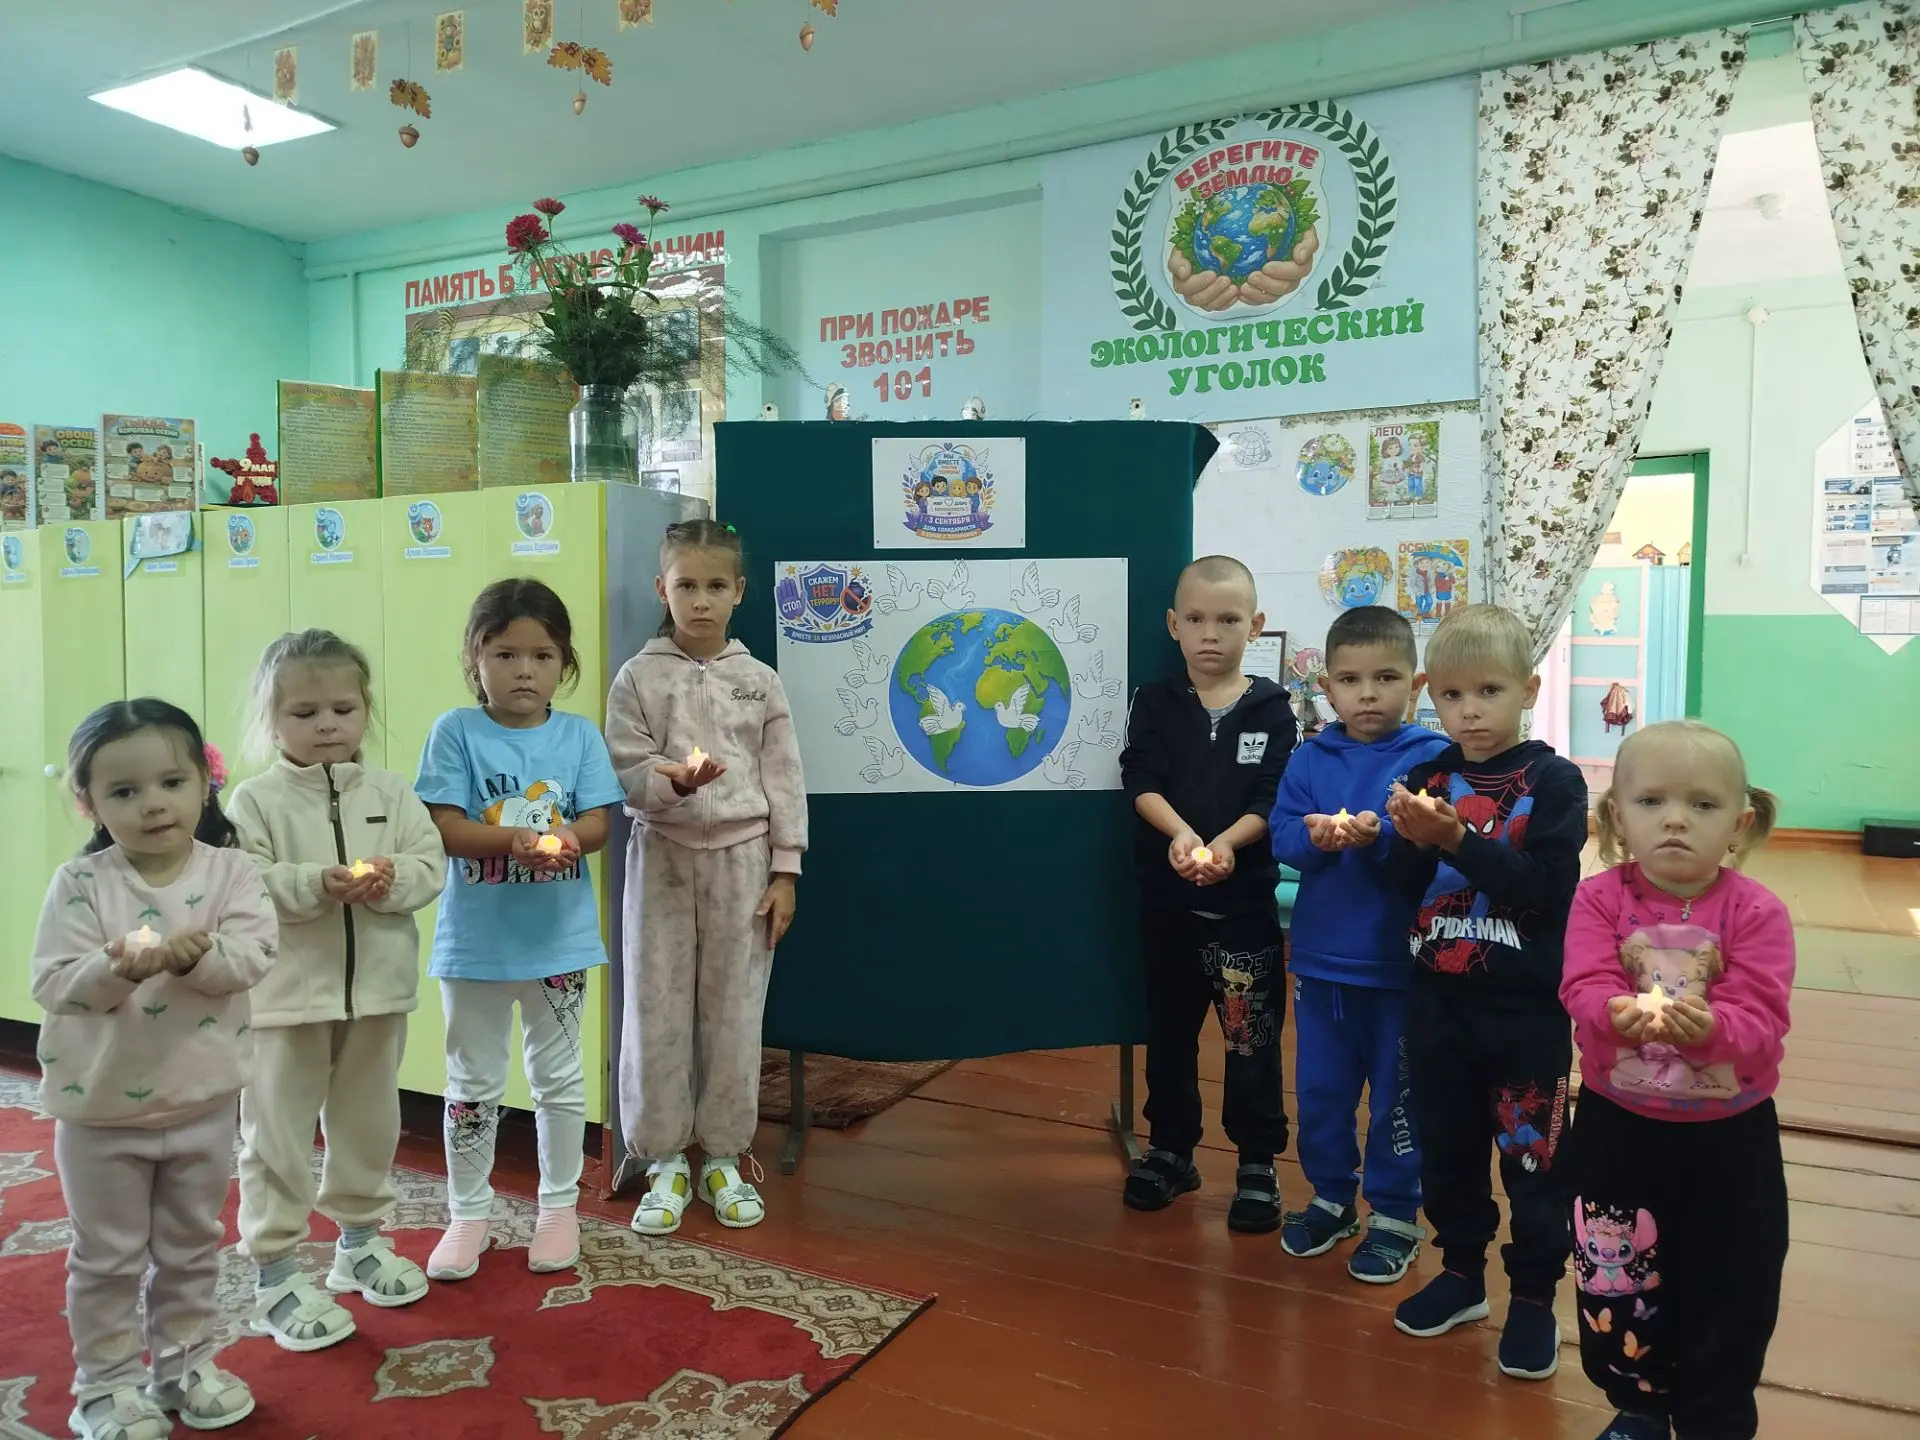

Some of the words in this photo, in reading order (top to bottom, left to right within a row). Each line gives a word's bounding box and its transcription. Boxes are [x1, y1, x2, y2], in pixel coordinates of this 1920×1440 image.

[1174, 140, 1319, 191] БЕРЕГИТЕ
[1198, 165, 1294, 200] ЗЕМЛЮ
[405, 268, 495, 308] ПАМЯТЬ
[499, 249, 614, 294] БРЕЖНО
[820, 312, 874, 342] ПРИ
[881, 296, 990, 335] ПОЖАРЕ
[1091, 298, 1425, 368] ЭКОЛОГИЧЕСКИЙ
[840, 329, 975, 368] ЗВОНИТЬ
[873, 366, 932, 403] 101
[1168, 353, 1326, 396] УГОЛОК
[1374, 425, 1404, 437] ЛЕТО
[239, 458, 252, 471] 9
[251, 464, 275, 472] МАЯ
[923, 524, 937, 532] ДЕНЬ
[934, 517, 971, 525] СЕНТЯБРЯ
[807, 576, 839, 586] СКАЖЕМ
[812, 584, 836, 598] НЕТ
[782, 600, 802, 613] СТОП
[731, 688, 767, 702] Smile
[477, 773, 520, 801] LAZY
